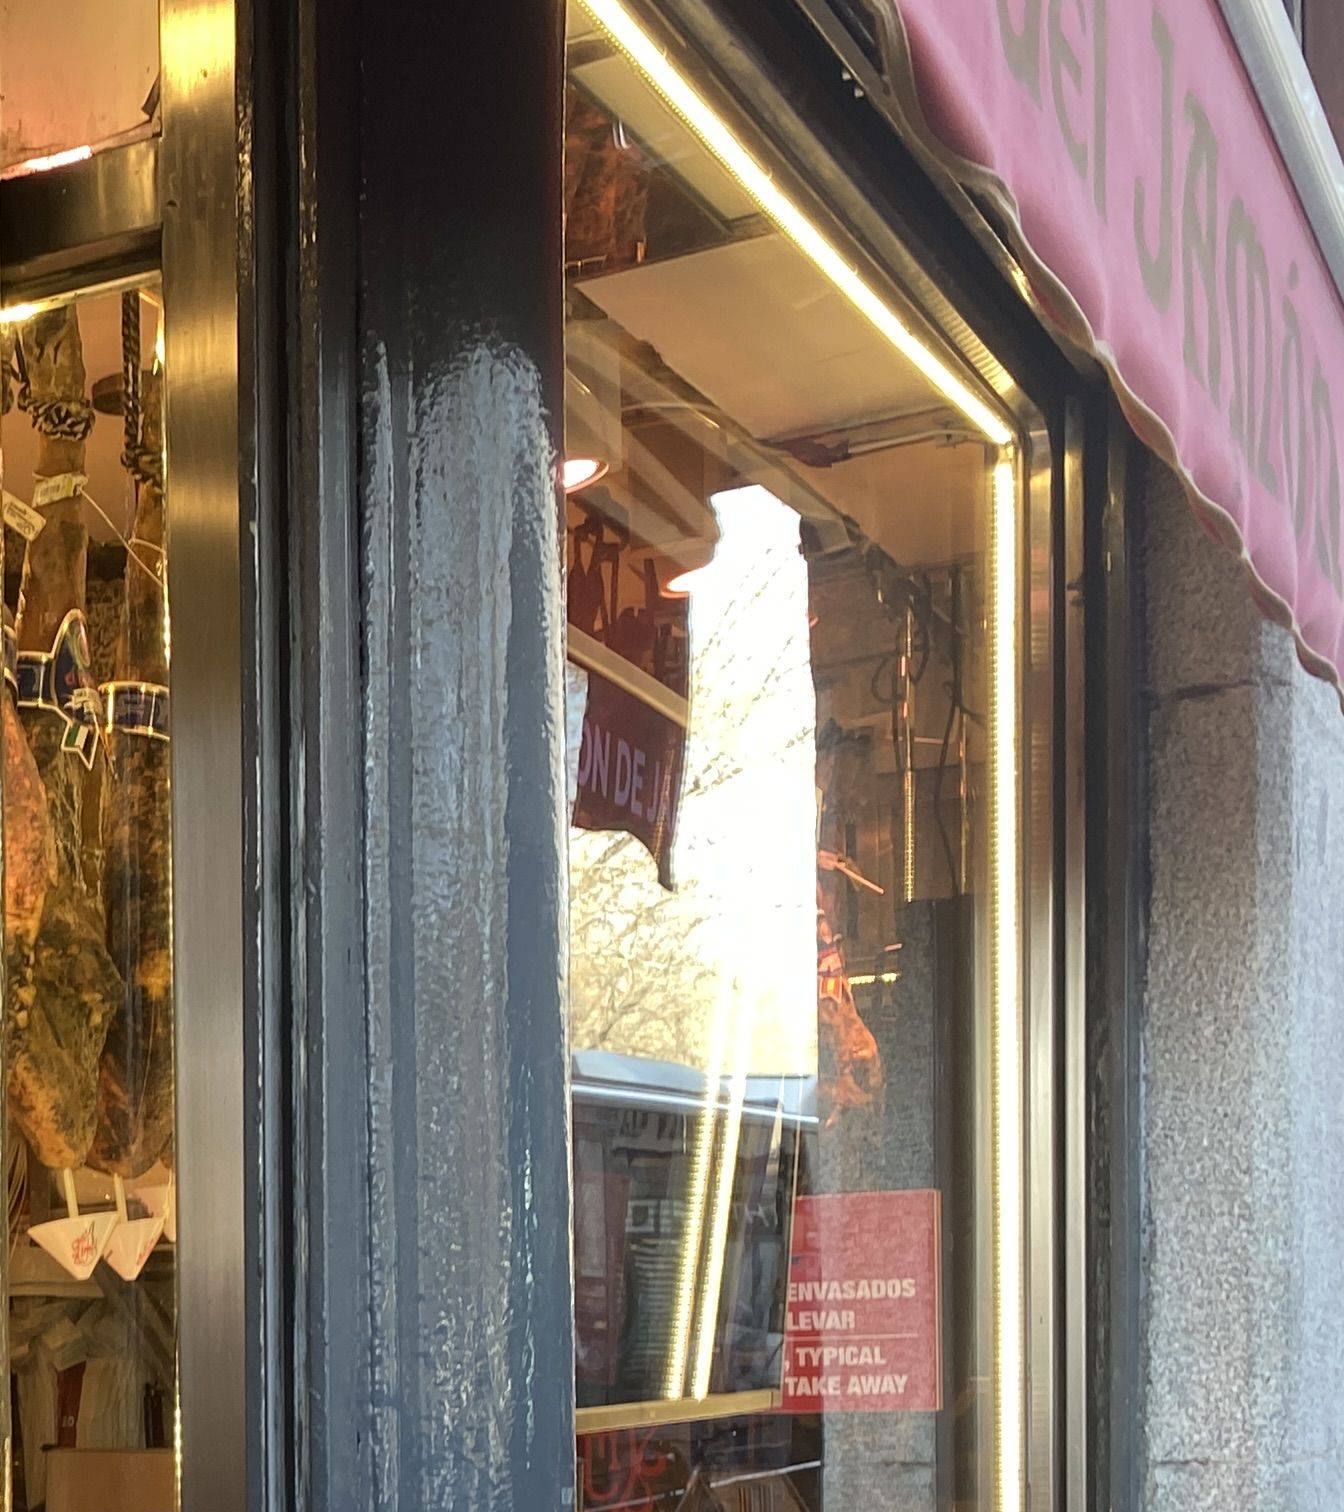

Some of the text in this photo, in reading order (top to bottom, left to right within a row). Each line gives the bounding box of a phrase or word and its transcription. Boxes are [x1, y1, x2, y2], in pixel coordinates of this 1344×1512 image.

[614, 738, 646, 815] DE
[788, 1278, 916, 1302] ENVASADOS
[786, 1309, 856, 1331] LEVAR
[796, 1346, 888, 1367] TYPICAL
[785, 1374, 909, 1397] TAKE AWAY
